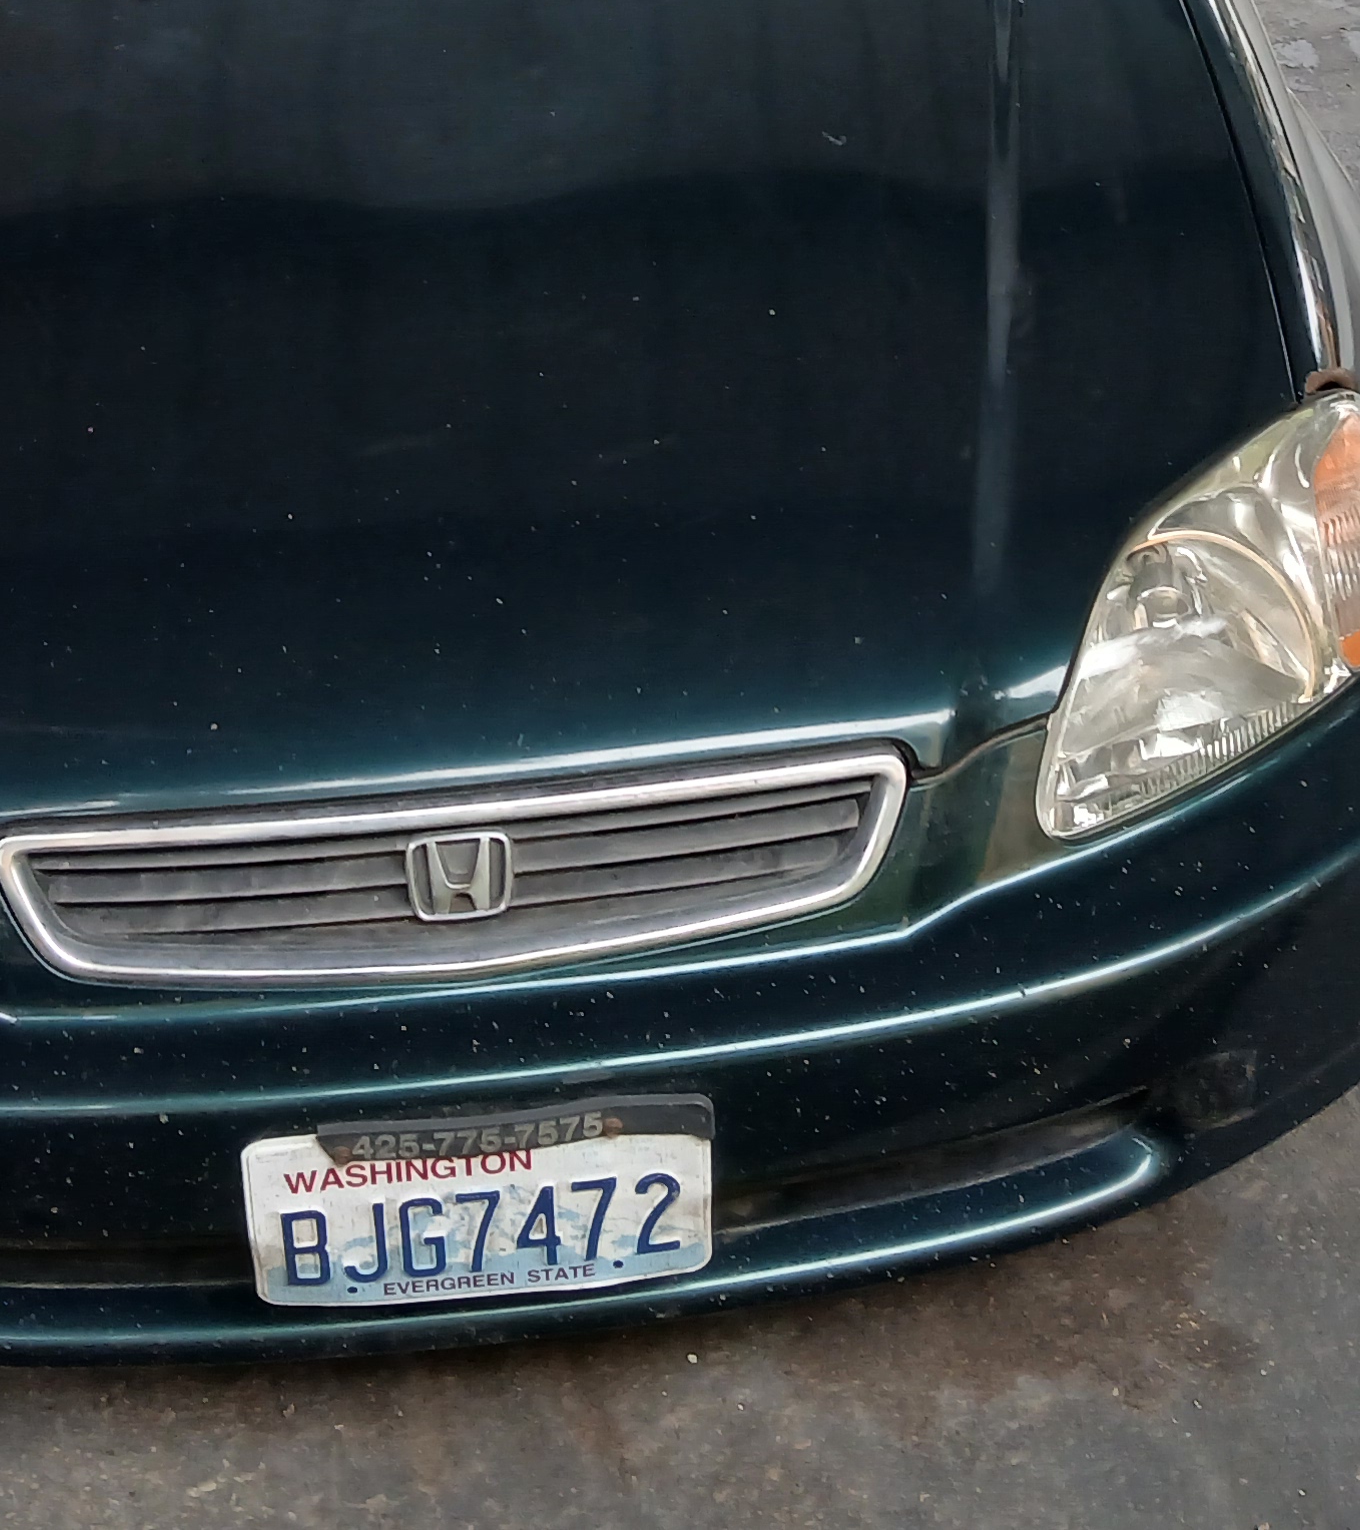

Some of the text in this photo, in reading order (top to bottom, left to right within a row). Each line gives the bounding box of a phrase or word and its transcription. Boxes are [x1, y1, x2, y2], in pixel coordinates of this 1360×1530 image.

[351, 1111, 604, 1160] 425-775-7575
[283, 1150, 533, 1195] WASHINGTON
[280, 1172, 682, 1286] BJG7472
[383, 1263, 596, 1296] EVERGREEN STATE
